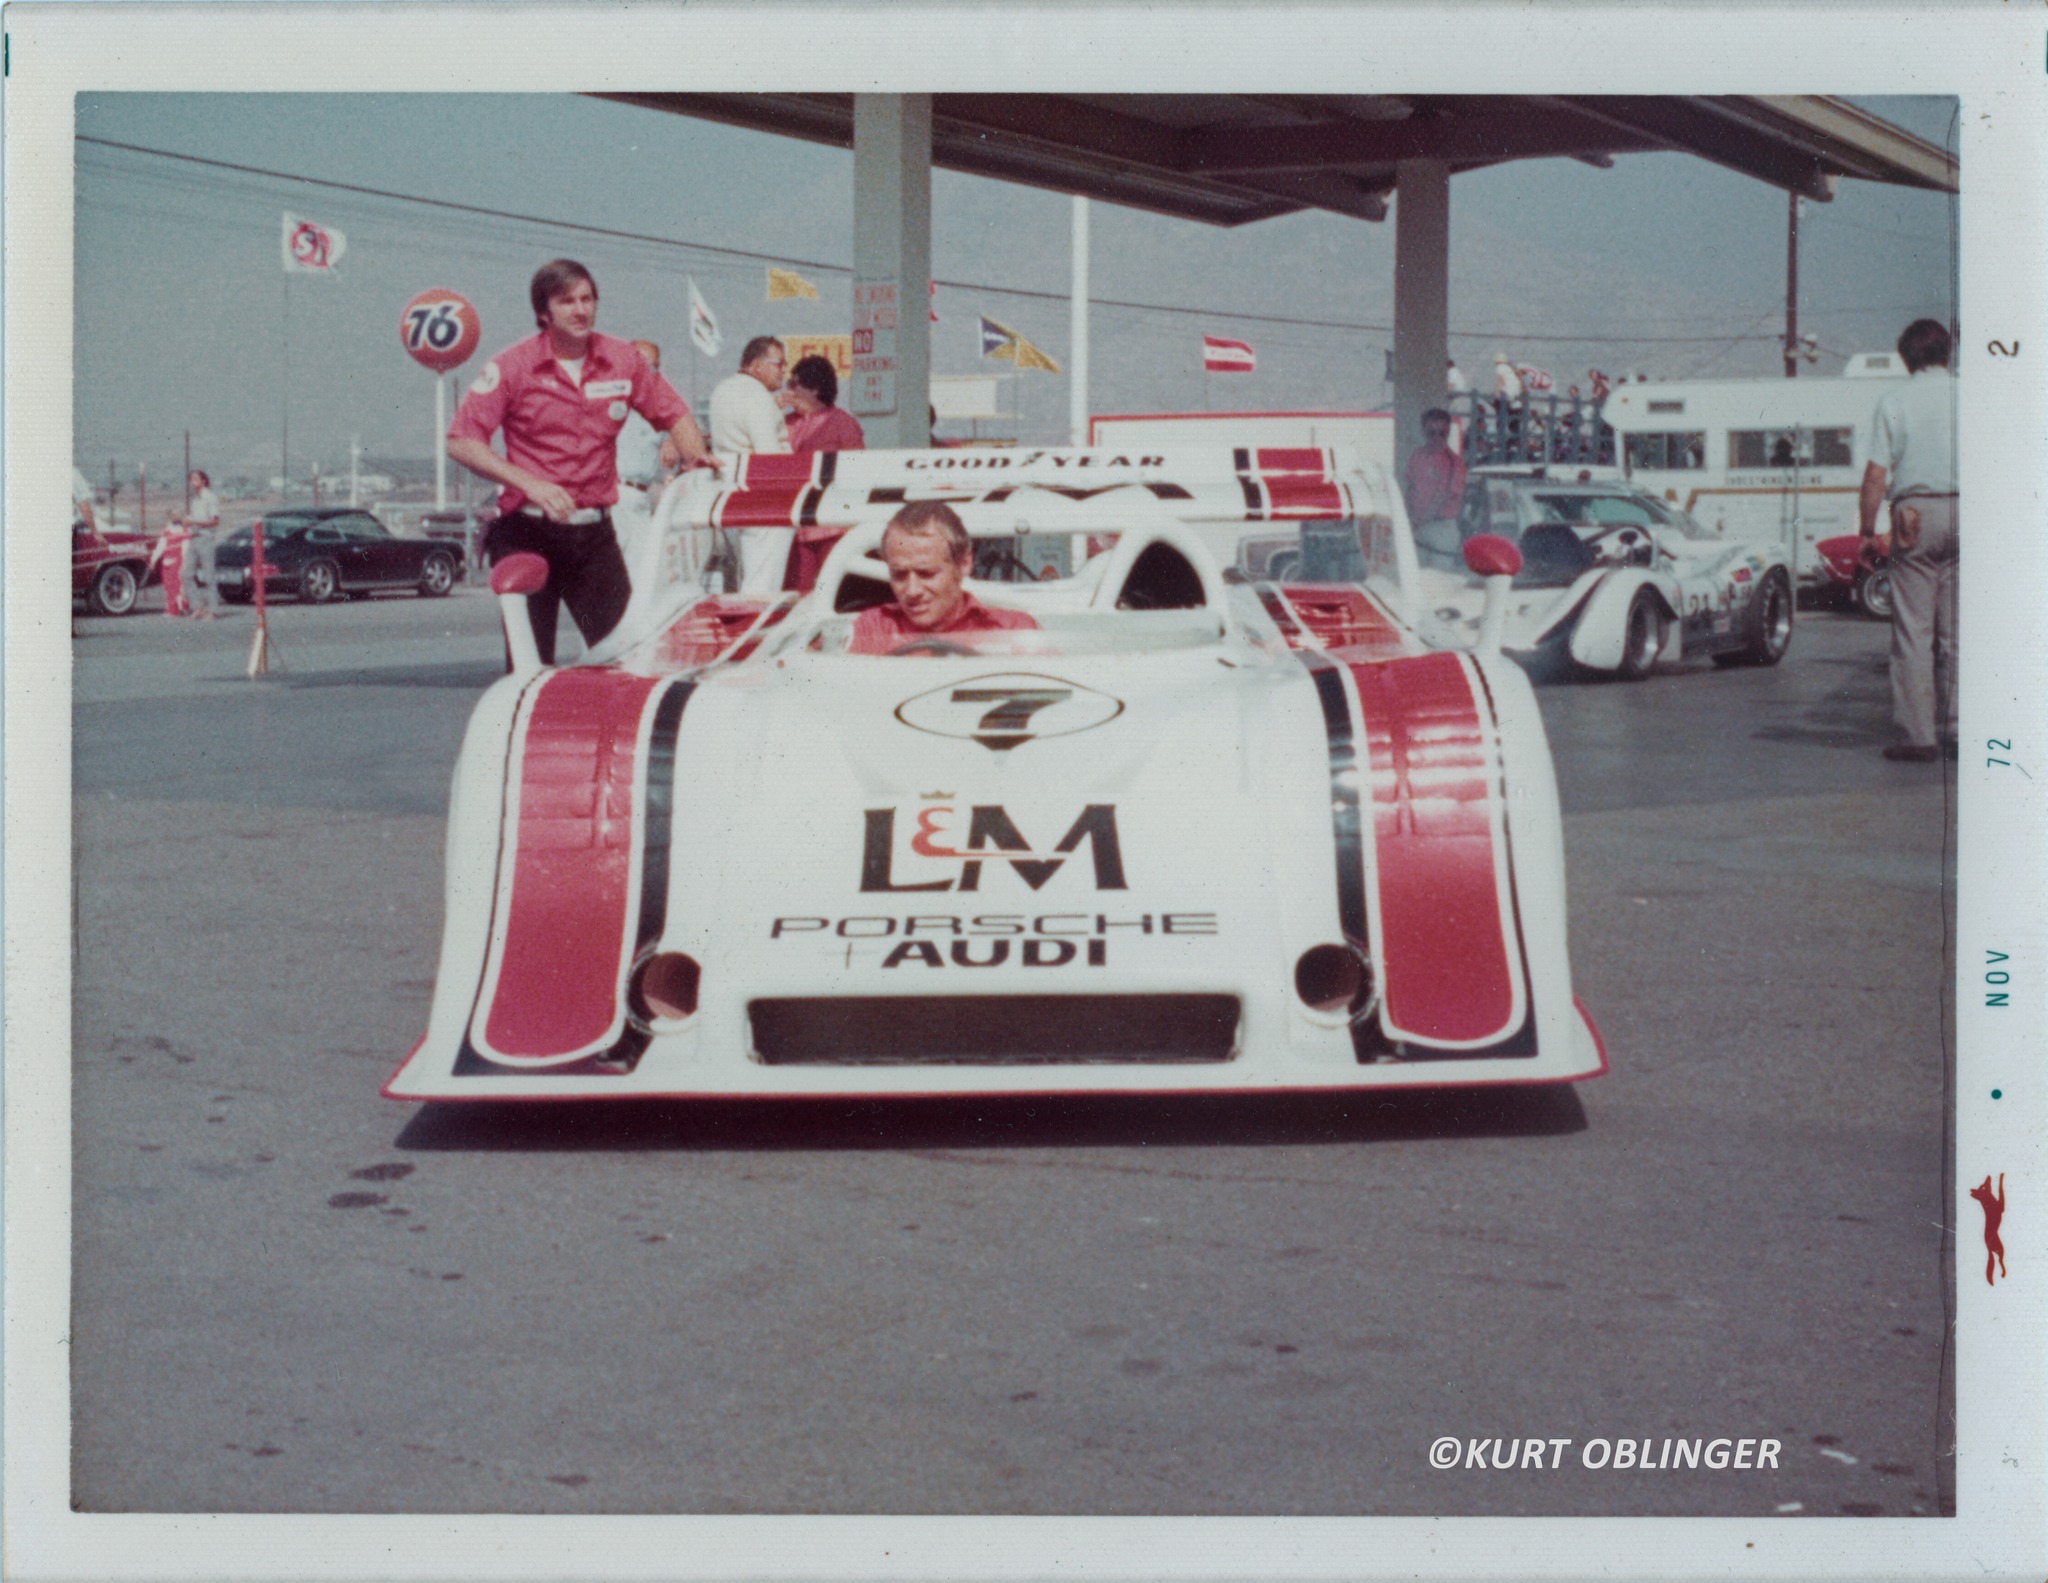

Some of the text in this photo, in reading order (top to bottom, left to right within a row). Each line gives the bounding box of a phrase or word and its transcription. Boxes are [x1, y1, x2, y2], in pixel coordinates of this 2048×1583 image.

[409, 305, 458, 349] 76
[853, 332, 871, 351] NO
[854, 358, 895, 371] PARKING
[950, 688, 1074, 731] 7
[769, 913, 1219, 939] PORSCHE
[881, 938, 1107, 969] AUDI
